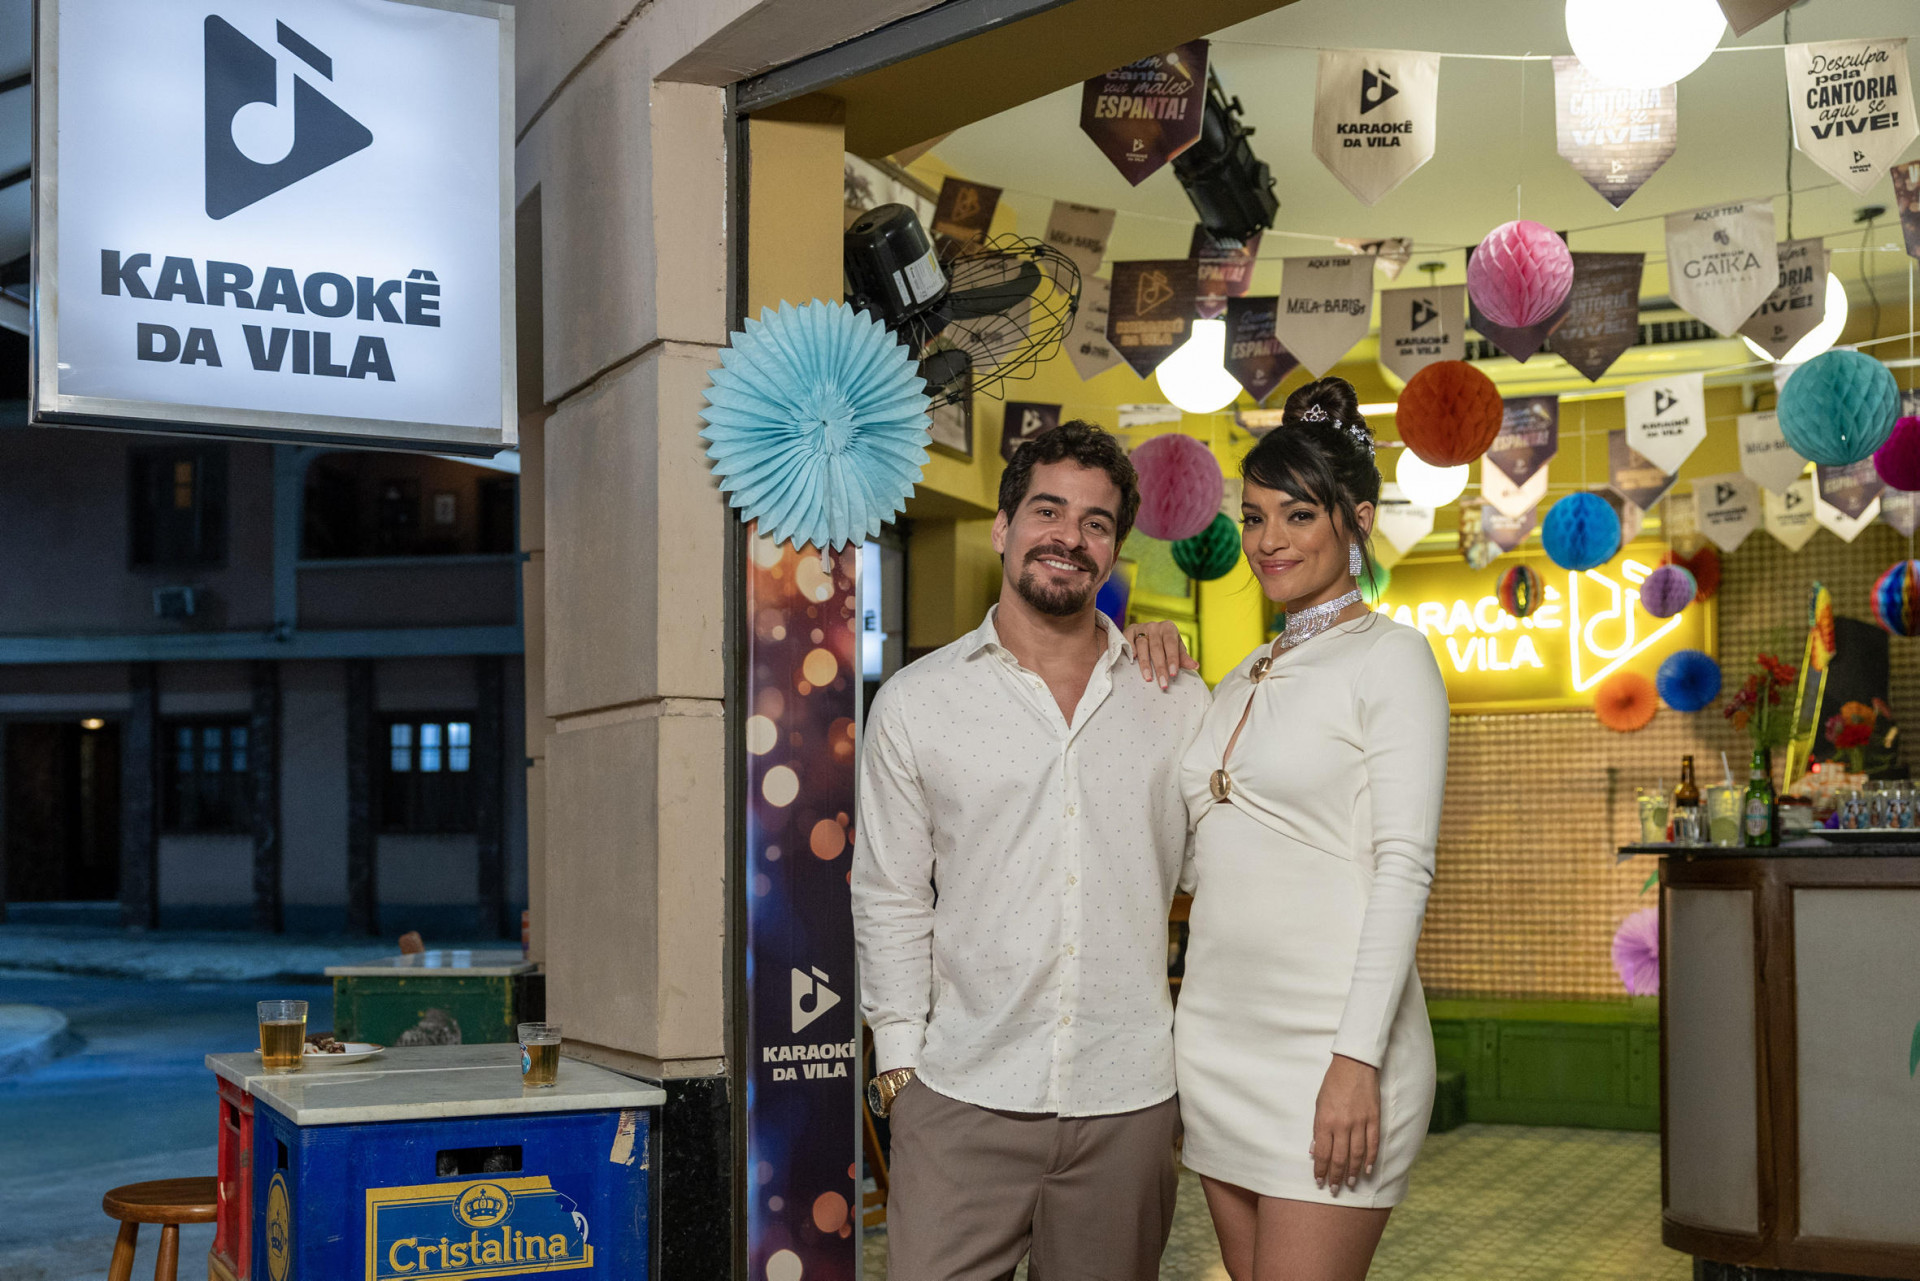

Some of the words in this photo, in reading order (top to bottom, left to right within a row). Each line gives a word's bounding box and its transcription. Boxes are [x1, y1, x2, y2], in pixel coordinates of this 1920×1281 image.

[1808, 46, 1889, 75] Desculpa
[1815, 69, 1861, 87] pela
[1807, 74, 1898, 110] CANTORIA
[1094, 95, 1189, 120] ESPANTA!
[1819, 104, 1860, 126] aqui
[1868, 99, 1887, 115] se
[1336, 120, 1413, 134] KARAOKÊ
[1570, 123, 1661, 147] VIVE!
[1810, 111, 1900, 140] VIVE!
[1343, 138, 1362, 148] DA
[1366, 136, 1401, 148] VILA
[1683, 252, 1761, 279] GAIKA
[101, 248, 441, 327] KARAOKÊ
[137, 322, 222, 368] DA
[242, 324, 396, 382] VILA
[1445, 634, 1544, 673] VILA
[773, 1067, 798, 1082] DA
[802, 1061, 848, 1080] VILA
[388, 1225, 570, 1273] Cristalina
